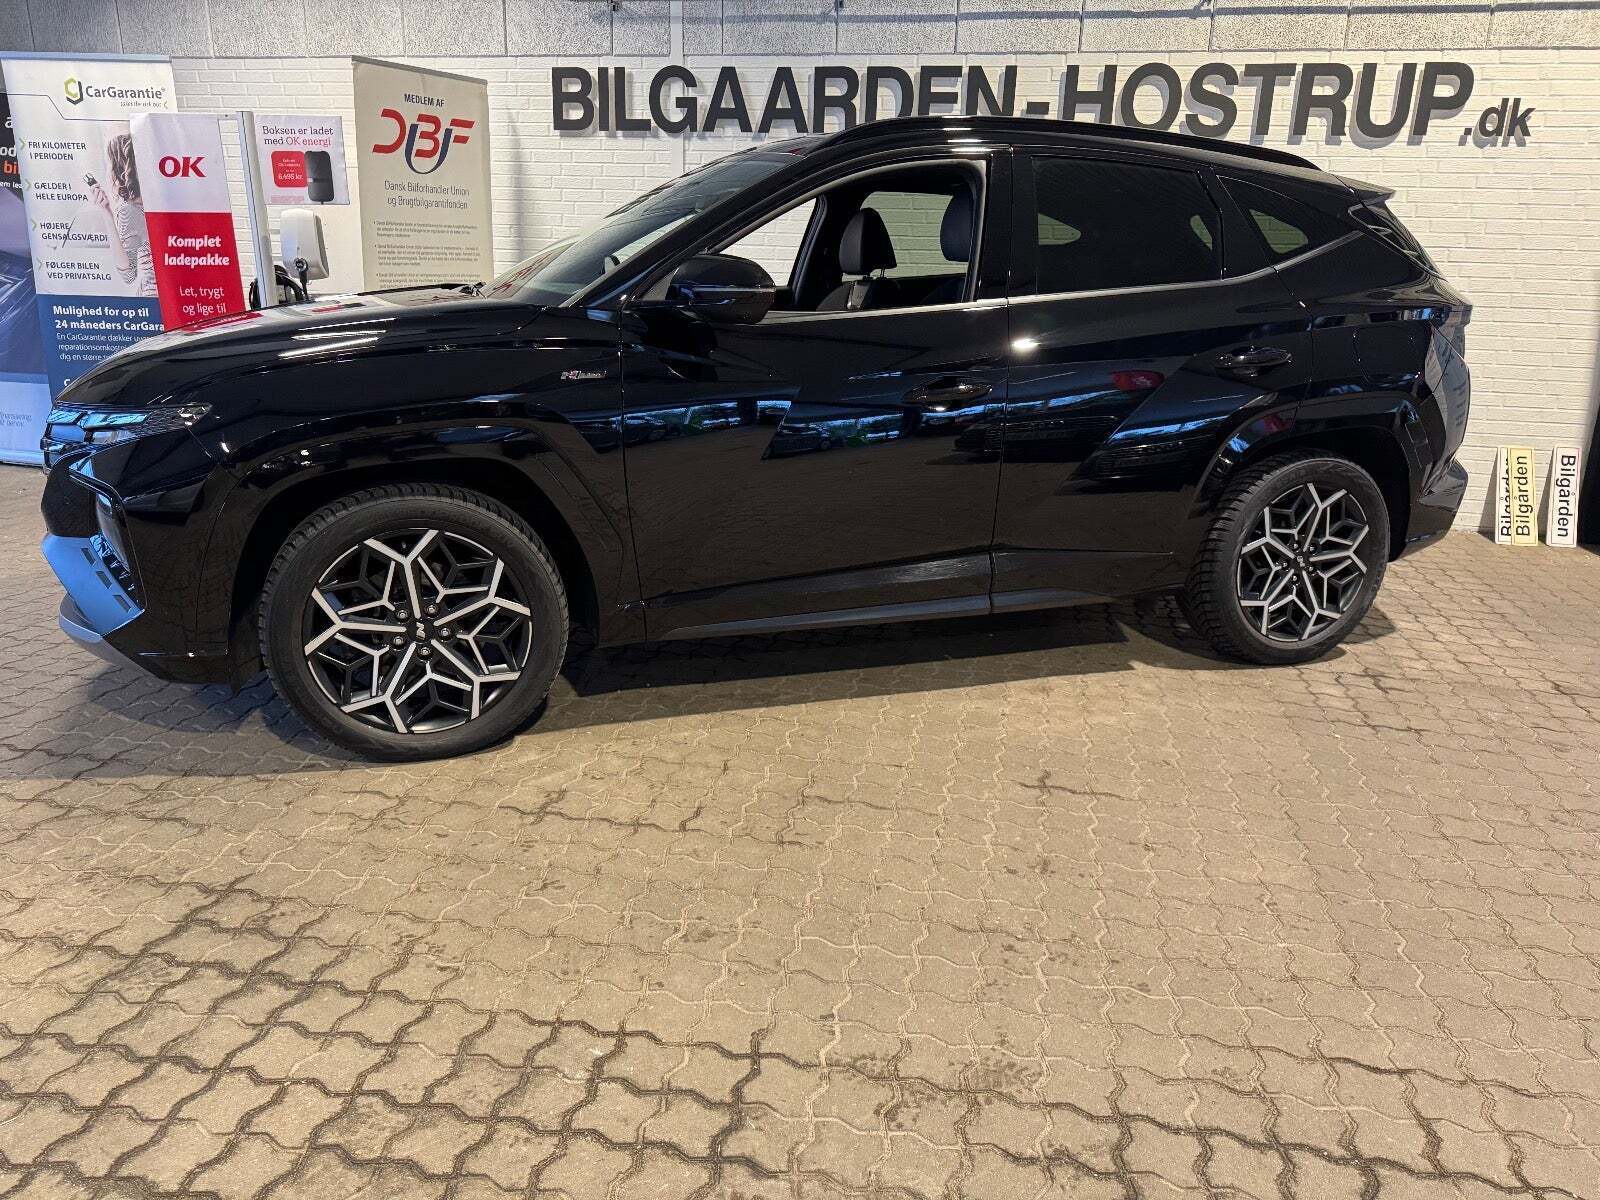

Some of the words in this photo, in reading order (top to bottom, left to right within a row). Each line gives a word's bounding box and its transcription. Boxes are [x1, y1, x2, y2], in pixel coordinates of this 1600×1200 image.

[404, 93, 435, 107] MEDLEM
[435, 98, 445, 108] AF
[262, 125, 296, 135] Boksen
[297, 127, 308, 135] er
[310, 126, 334, 135] ladet
[28, 141, 40, 149] FRI
[42, 142, 86, 150] KILOMETER
[264, 136, 284, 145] med
[286, 136, 301, 145] OK
[302, 137, 332, 148] energi
[35, 152, 74, 160] PERIODEN
[158, 155, 207, 178] OK
[34, 182, 68, 190] GÆLDER
[384, 180, 406, 192] Dansk
[407, 181, 449, 195] Bilforhandler
[450, 185, 470, 196] Union
[36, 192, 55, 201] HELE
[57, 193, 88, 201] EUROPA
[387, 196, 397, 207] og
[40, 222, 70, 230] HØJERE
[41, 232, 108, 242] GENSALGSVÆRDI
[167, 235, 222, 251] Komplet
[45, 261, 76, 269] FØLGER
[77, 262, 100, 270] BILEN
[164, 253, 230, 269] ladepakke
[65, 272, 112, 281] PRIVATSALG
[179, 286, 198, 298] Let,
[199, 286, 225, 299] trygt
[53, 305, 102, 318] Mulighed
[104, 306, 120, 316] for
[121, 309, 136, 319] op
[137, 307, 149, 317] til
[182, 305, 196, 316] og
[197, 302, 214, 316] lige
[216, 303, 227, 313] til
[55, 320, 68, 329] 24
[70, 320, 121, 330] måneders
[66, 333, 107, 341] CarGarantie
[107, 334, 132, 342] dækker
[59, 353, 71, 362] dig
[1514, 455, 1533, 536] Bilgården
[1555, 454, 1577, 537] Bilgården
